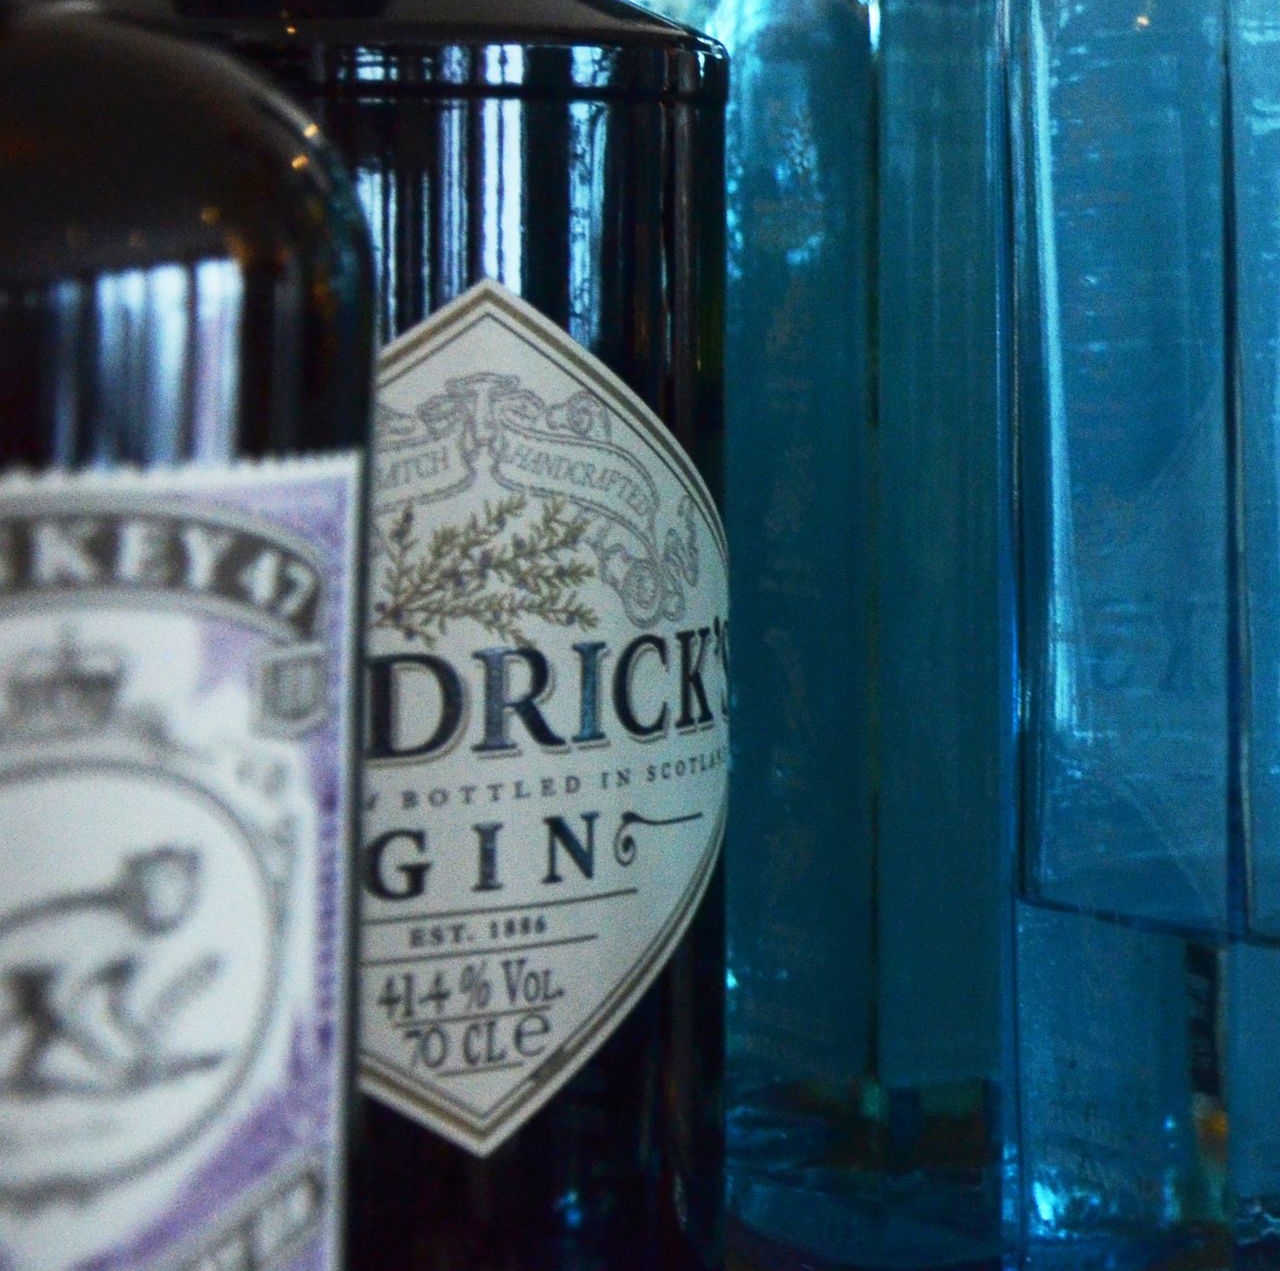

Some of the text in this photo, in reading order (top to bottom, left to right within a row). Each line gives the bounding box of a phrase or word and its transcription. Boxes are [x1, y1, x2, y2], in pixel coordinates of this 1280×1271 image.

[401, 775, 583, 811] BOTTLED
[600, 768, 632, 790] IN
[363, 811, 601, 902] GIN
